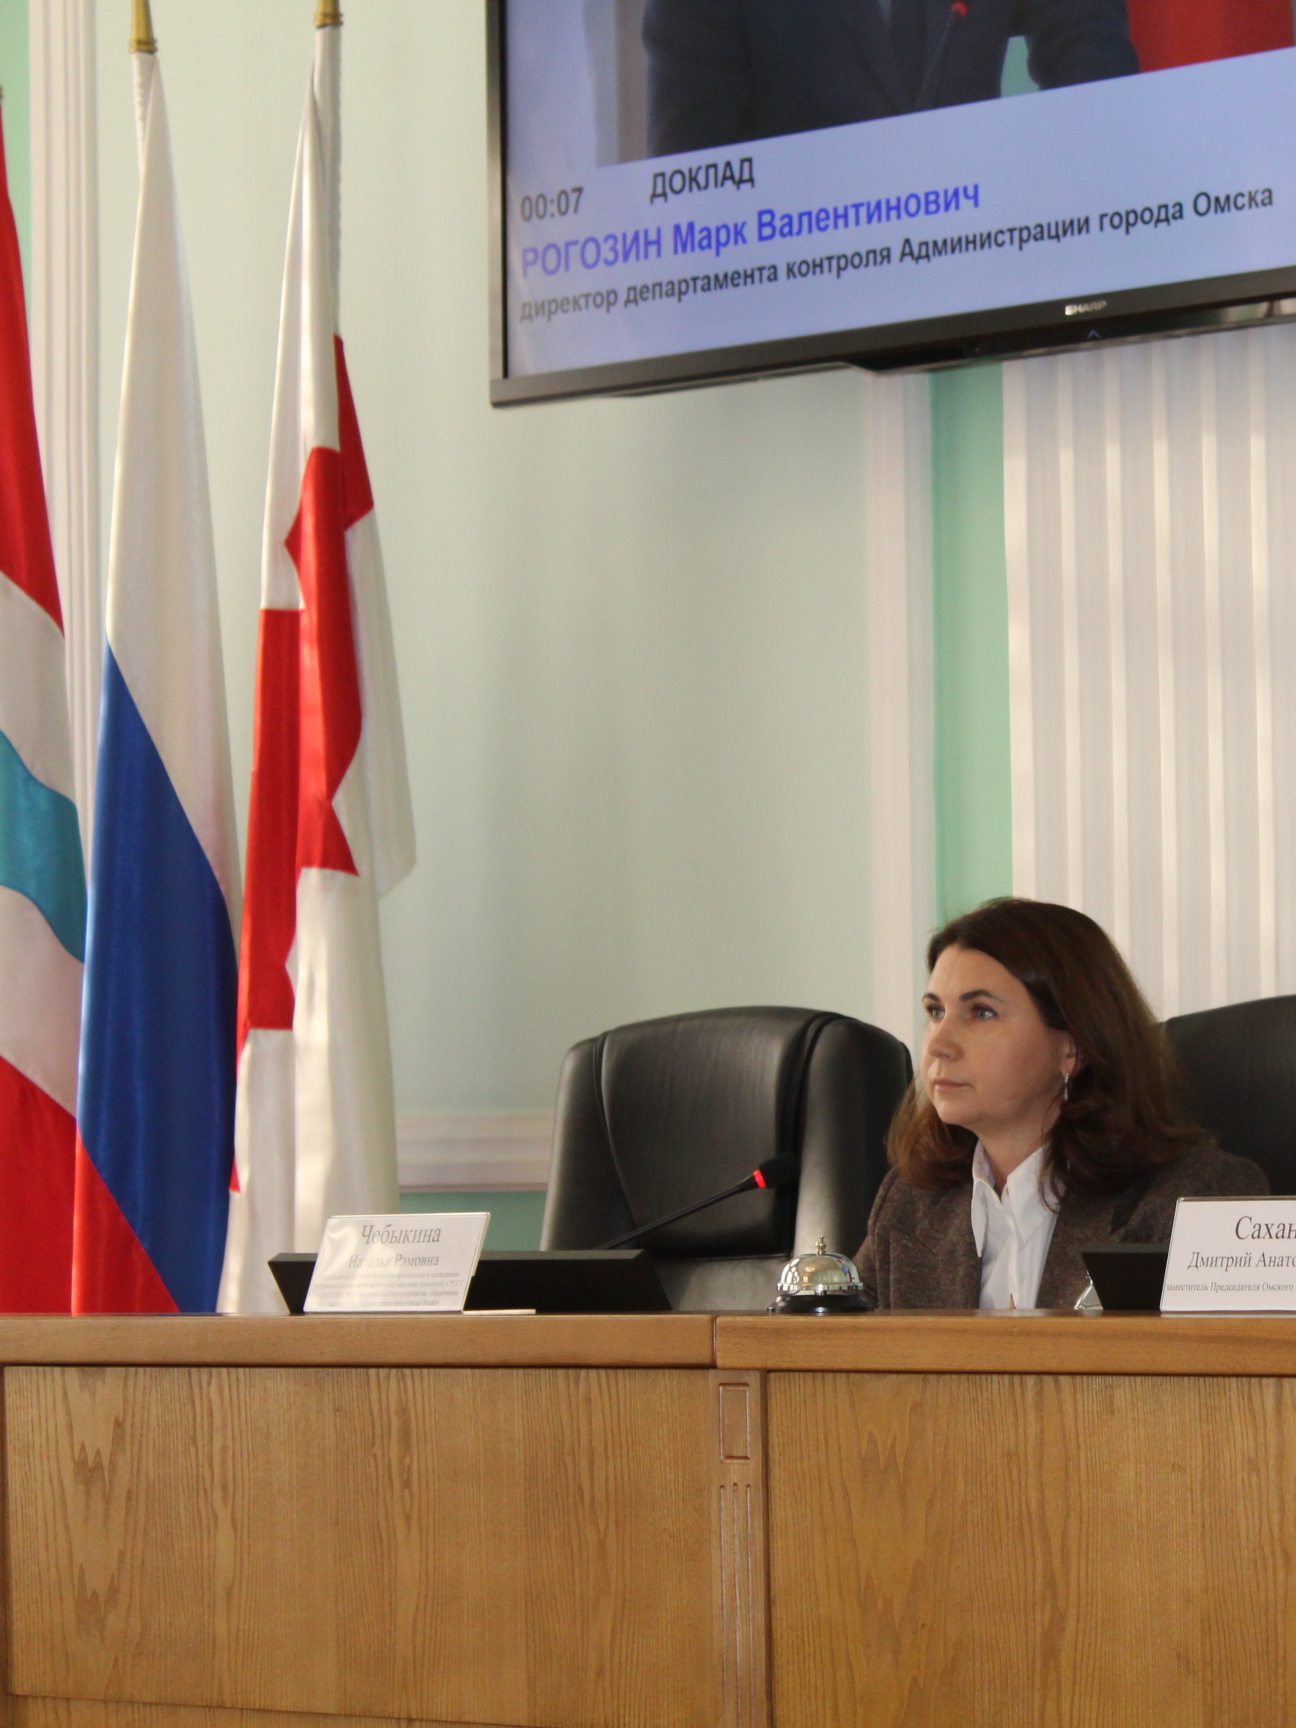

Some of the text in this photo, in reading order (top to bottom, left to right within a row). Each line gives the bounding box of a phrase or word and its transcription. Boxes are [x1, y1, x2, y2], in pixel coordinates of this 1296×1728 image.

[650, 157, 754, 203] ДОКЛАД
[520, 186, 584, 222] 00:07
[521, 183, 980, 279] РОГОЗИН Марк Валентинович
[519, 187, 1274, 322] директор департамента контроля Администрации города Омска
[361, 1223, 442, 1245] Чебыкина
[394, 1253, 440, 1268] Рэмовна
[1187, 1252, 1252, 1272] Дмитрий
[1210, 1282, 1260, 1293] Председателя
[1261, 1282, 1294, 1291] Омского
